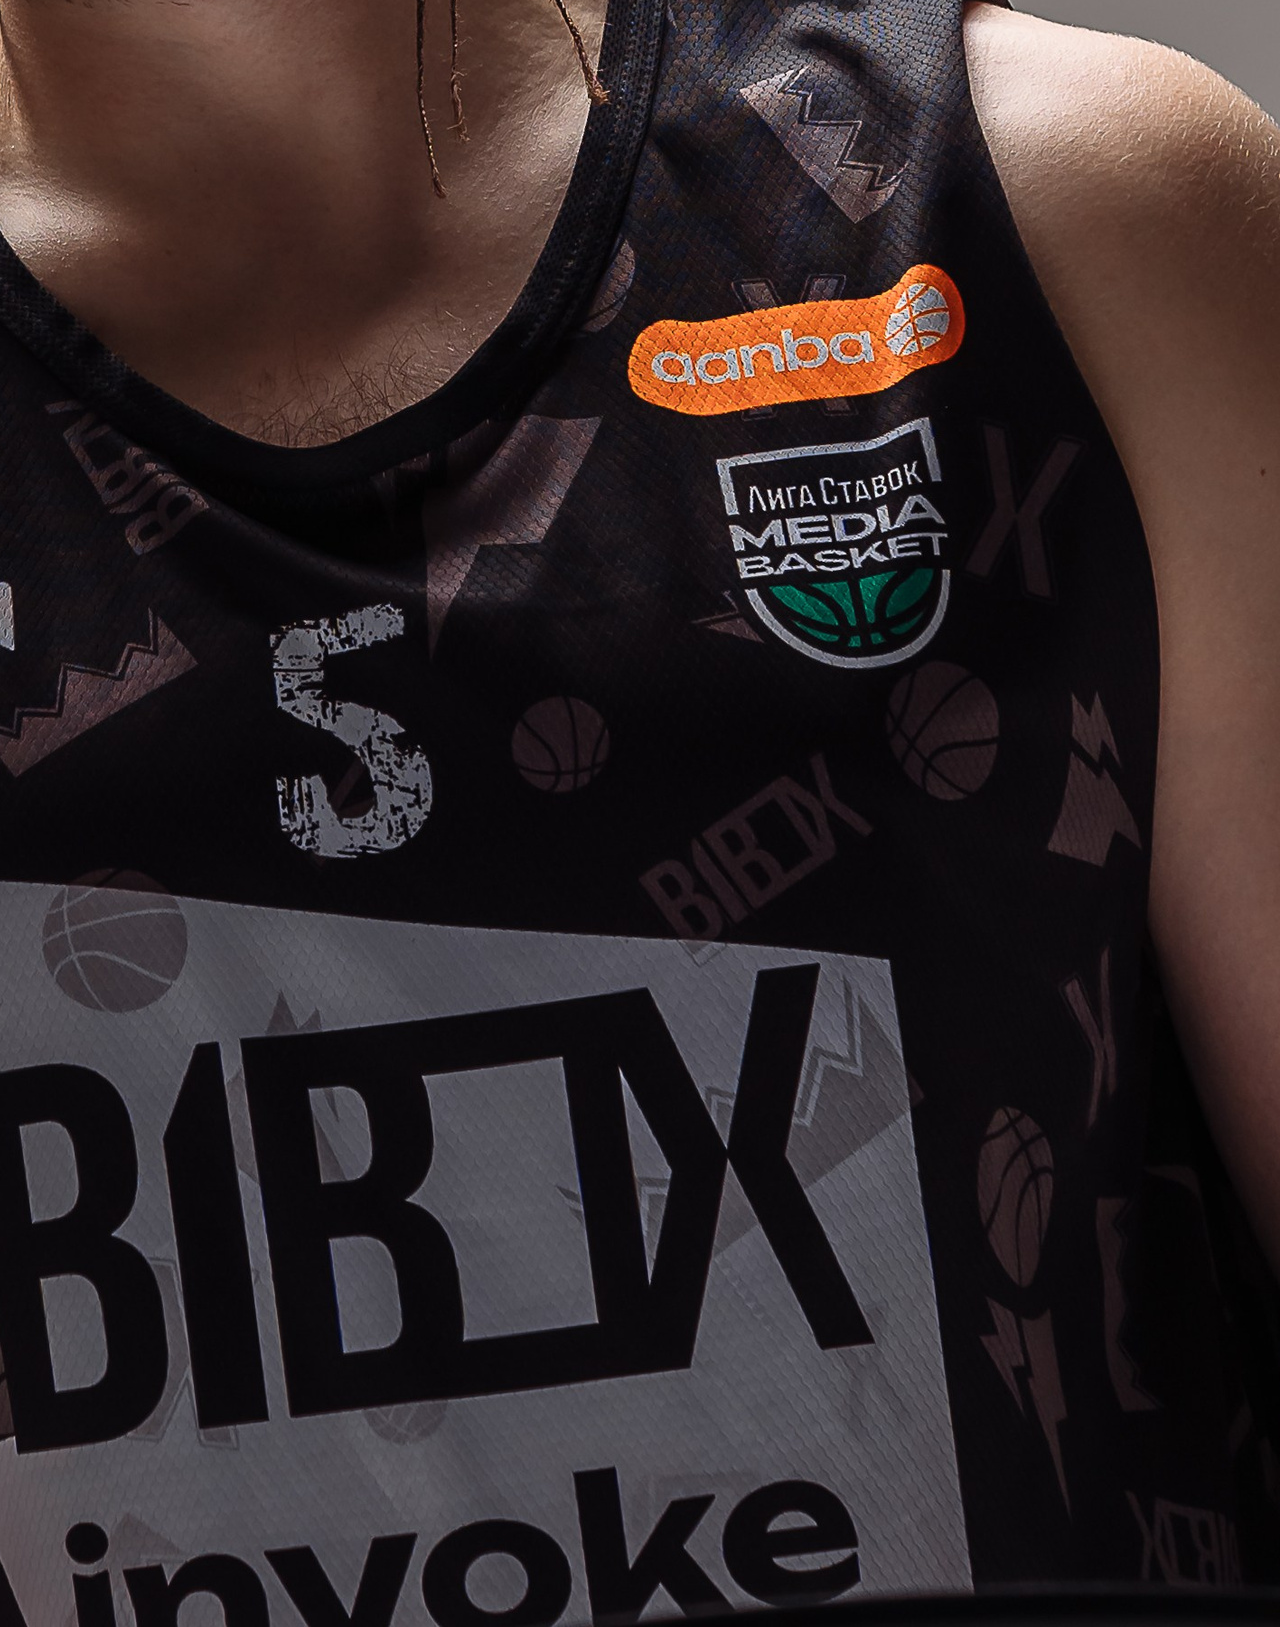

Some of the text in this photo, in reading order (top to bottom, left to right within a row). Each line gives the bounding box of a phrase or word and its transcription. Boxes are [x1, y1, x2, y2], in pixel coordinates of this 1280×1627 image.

[729, 494, 946, 552] MEDIA
[736, 532, 948, 580] BASKET
[269, 602, 433, 860] 5
